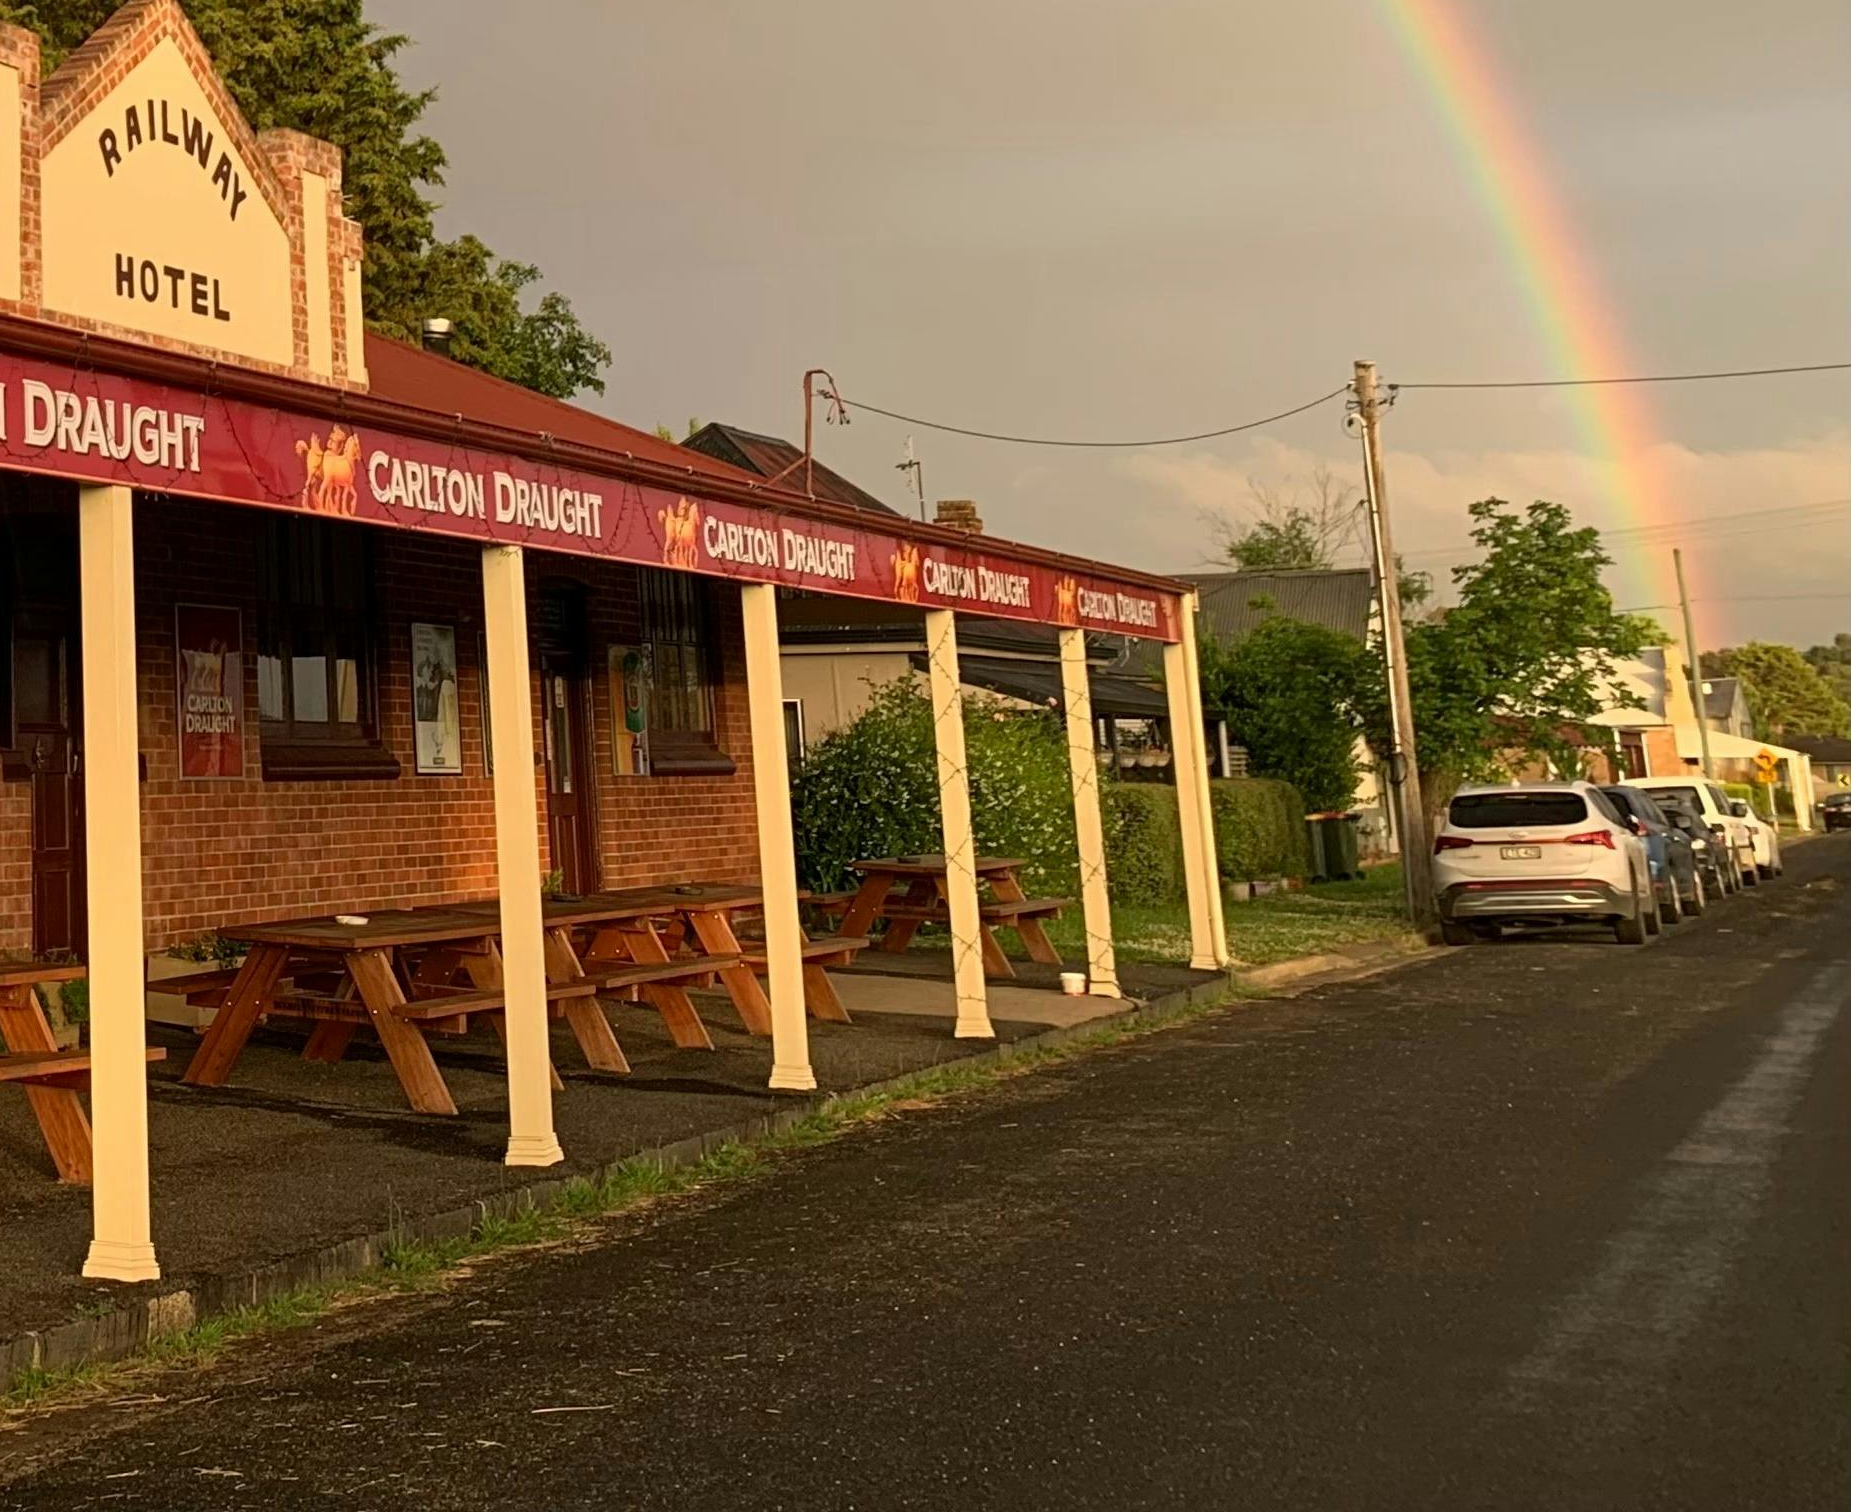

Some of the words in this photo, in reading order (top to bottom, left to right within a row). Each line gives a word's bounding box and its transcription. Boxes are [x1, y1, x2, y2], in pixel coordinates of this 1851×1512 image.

[98, 99, 247, 222] RAILWAY
[115, 253, 230, 322] HOTEL
[23, 378, 205, 472] DRAUGHT
[368, 450, 487, 520] CARLTON
[493, 471, 602, 538] DRAUGHT
[703, 515, 780, 568] CARLTON
[781, 528, 856, 581] DRAUGHT
[922, 557, 977, 600] CARLTON
[977, 565, 1031, 608] DRAUGHT
[185, 713, 235, 734] DRAUGHT
[186, 694, 233, 713] CARLTON
